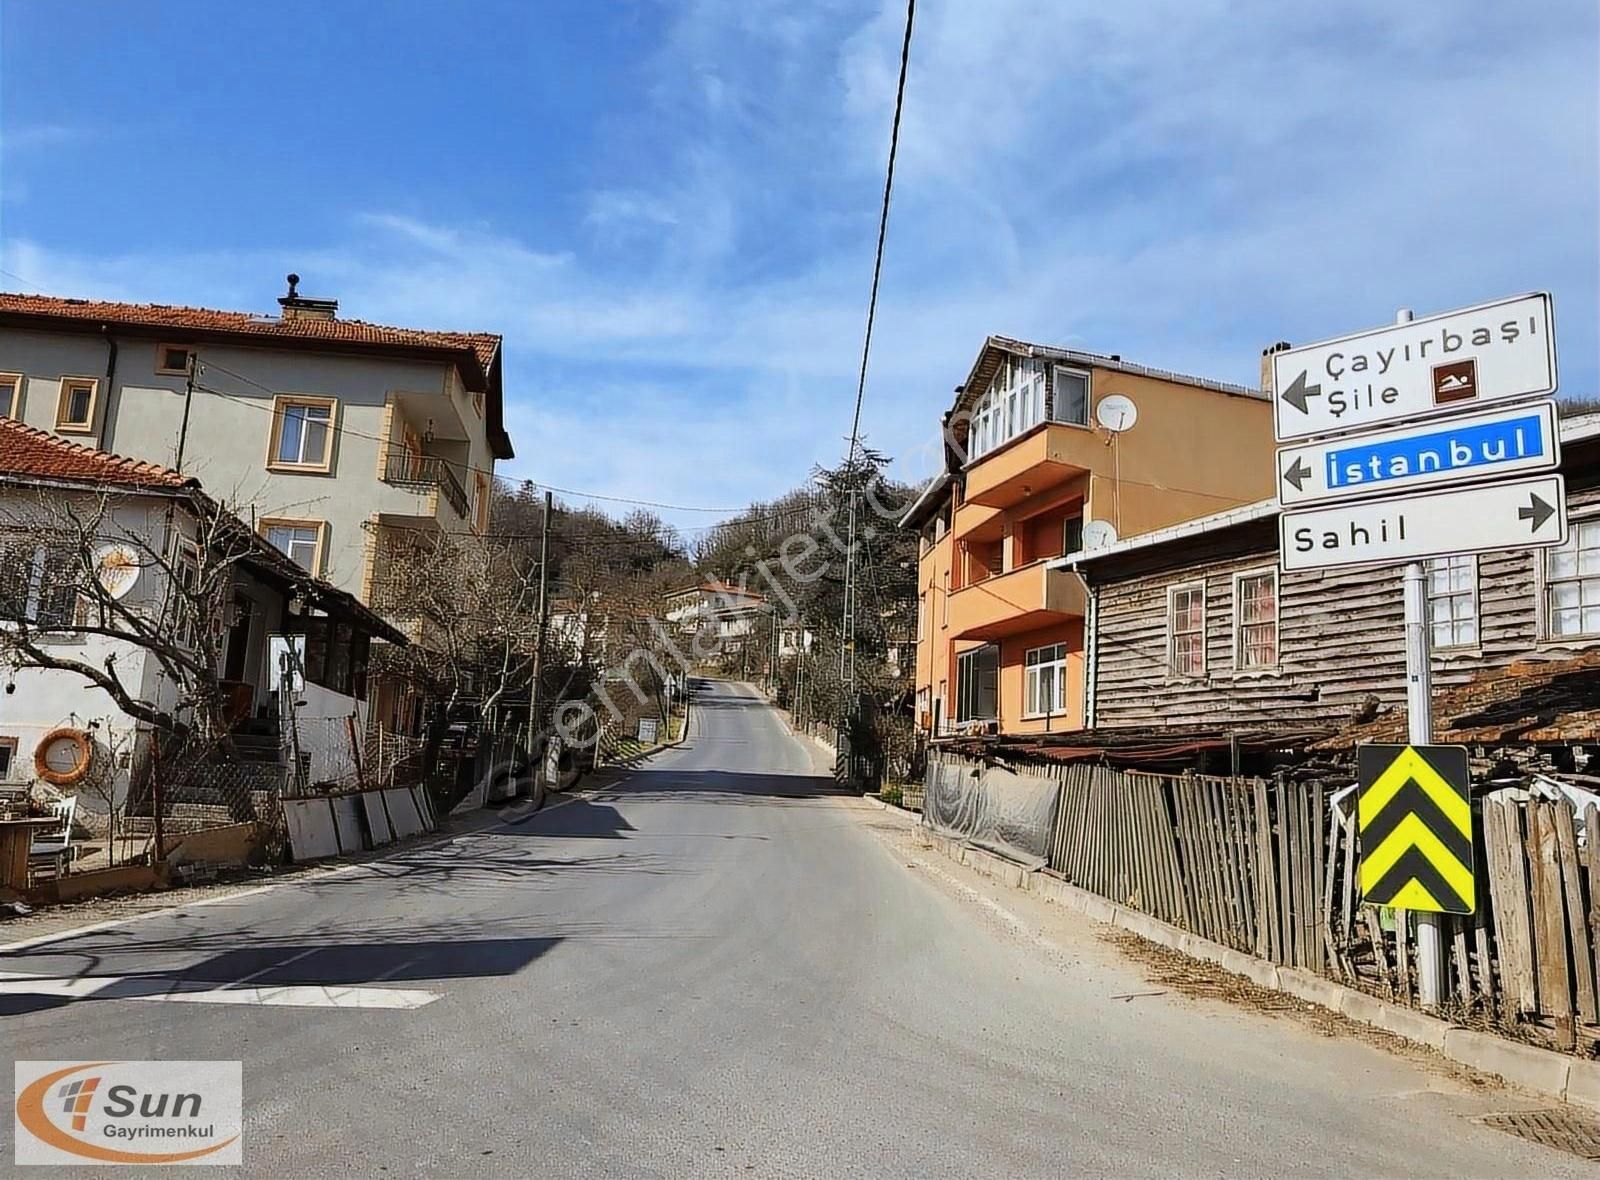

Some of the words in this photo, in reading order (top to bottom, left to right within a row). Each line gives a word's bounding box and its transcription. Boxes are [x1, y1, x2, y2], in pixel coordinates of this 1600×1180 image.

[1325, 316, 1537, 381] Çayırbaşı
[1327, 384, 1400, 417] Şile
[1329, 429, 1527, 487] İstanbul
[1294, 515, 1406, 552] Sahil
